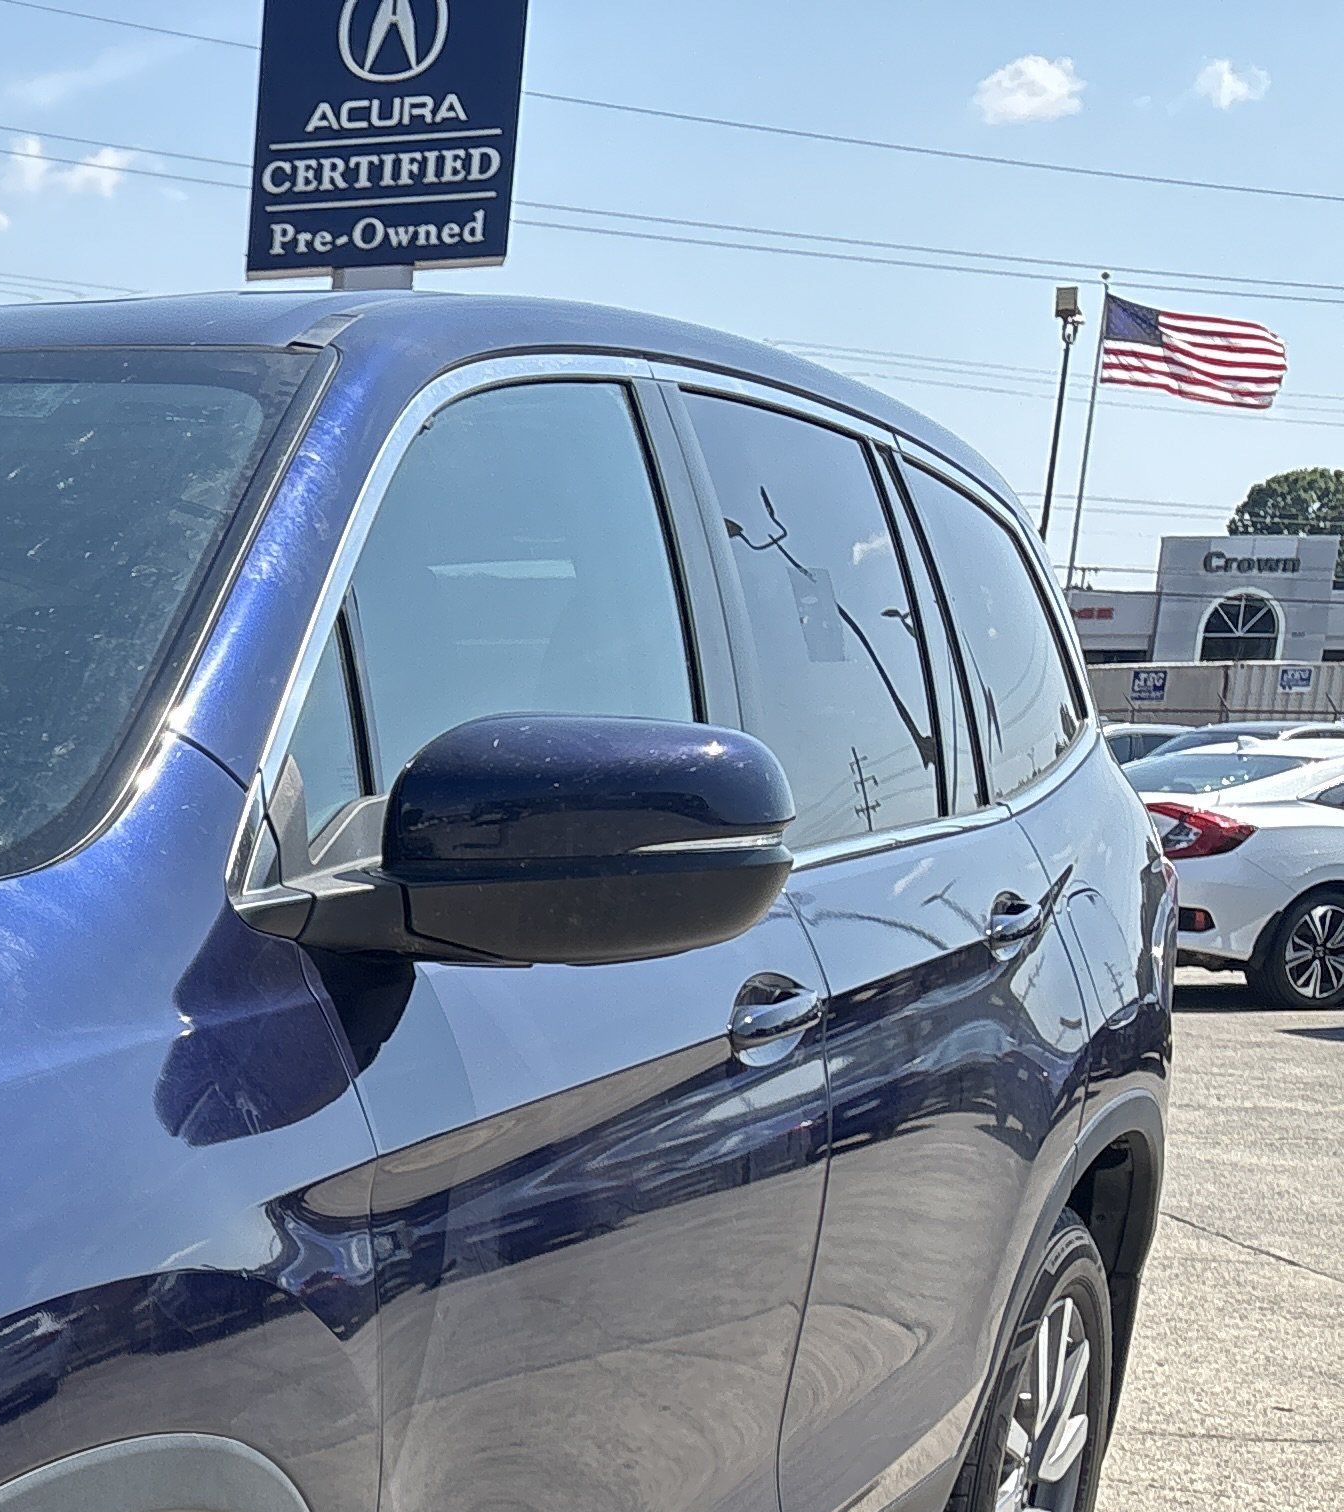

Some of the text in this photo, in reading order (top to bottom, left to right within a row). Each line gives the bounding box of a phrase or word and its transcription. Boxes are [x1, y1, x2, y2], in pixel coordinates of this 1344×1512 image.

[304, 93, 468, 133] ACURA
[262, 146, 501, 194] CERTIFIED
[269, 209, 486, 255] Pre-Owned
[1203, 551, 1300, 574] Crown
